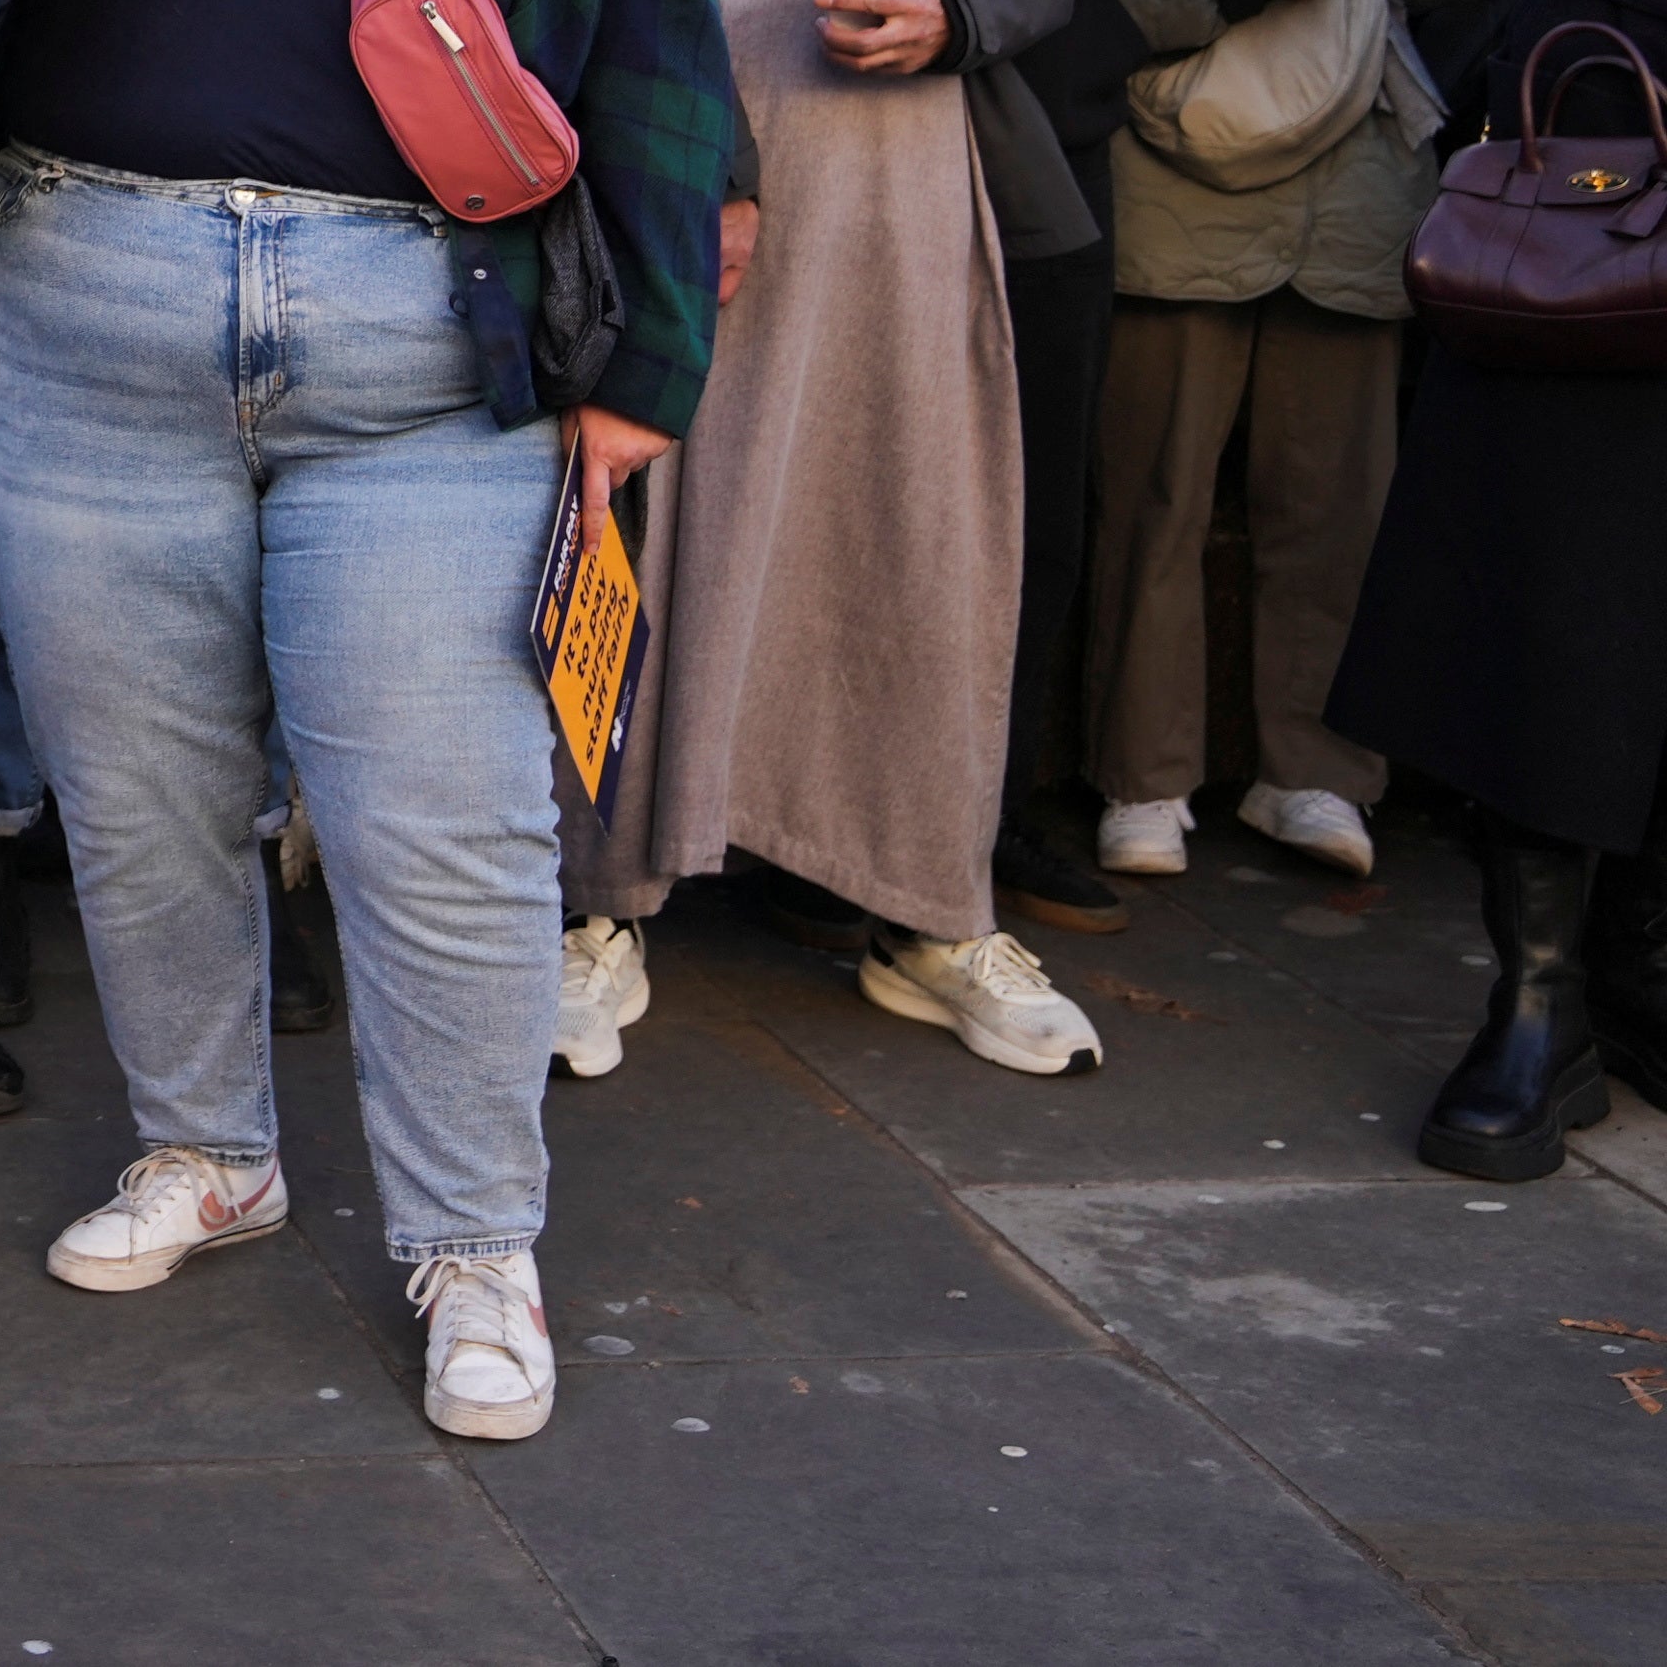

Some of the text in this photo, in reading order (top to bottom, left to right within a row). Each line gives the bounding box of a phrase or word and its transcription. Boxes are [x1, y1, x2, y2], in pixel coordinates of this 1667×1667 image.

[582, 579, 618, 718] nursing
[585, 676, 609, 766] staff
[606, 580, 631, 676] fairly
